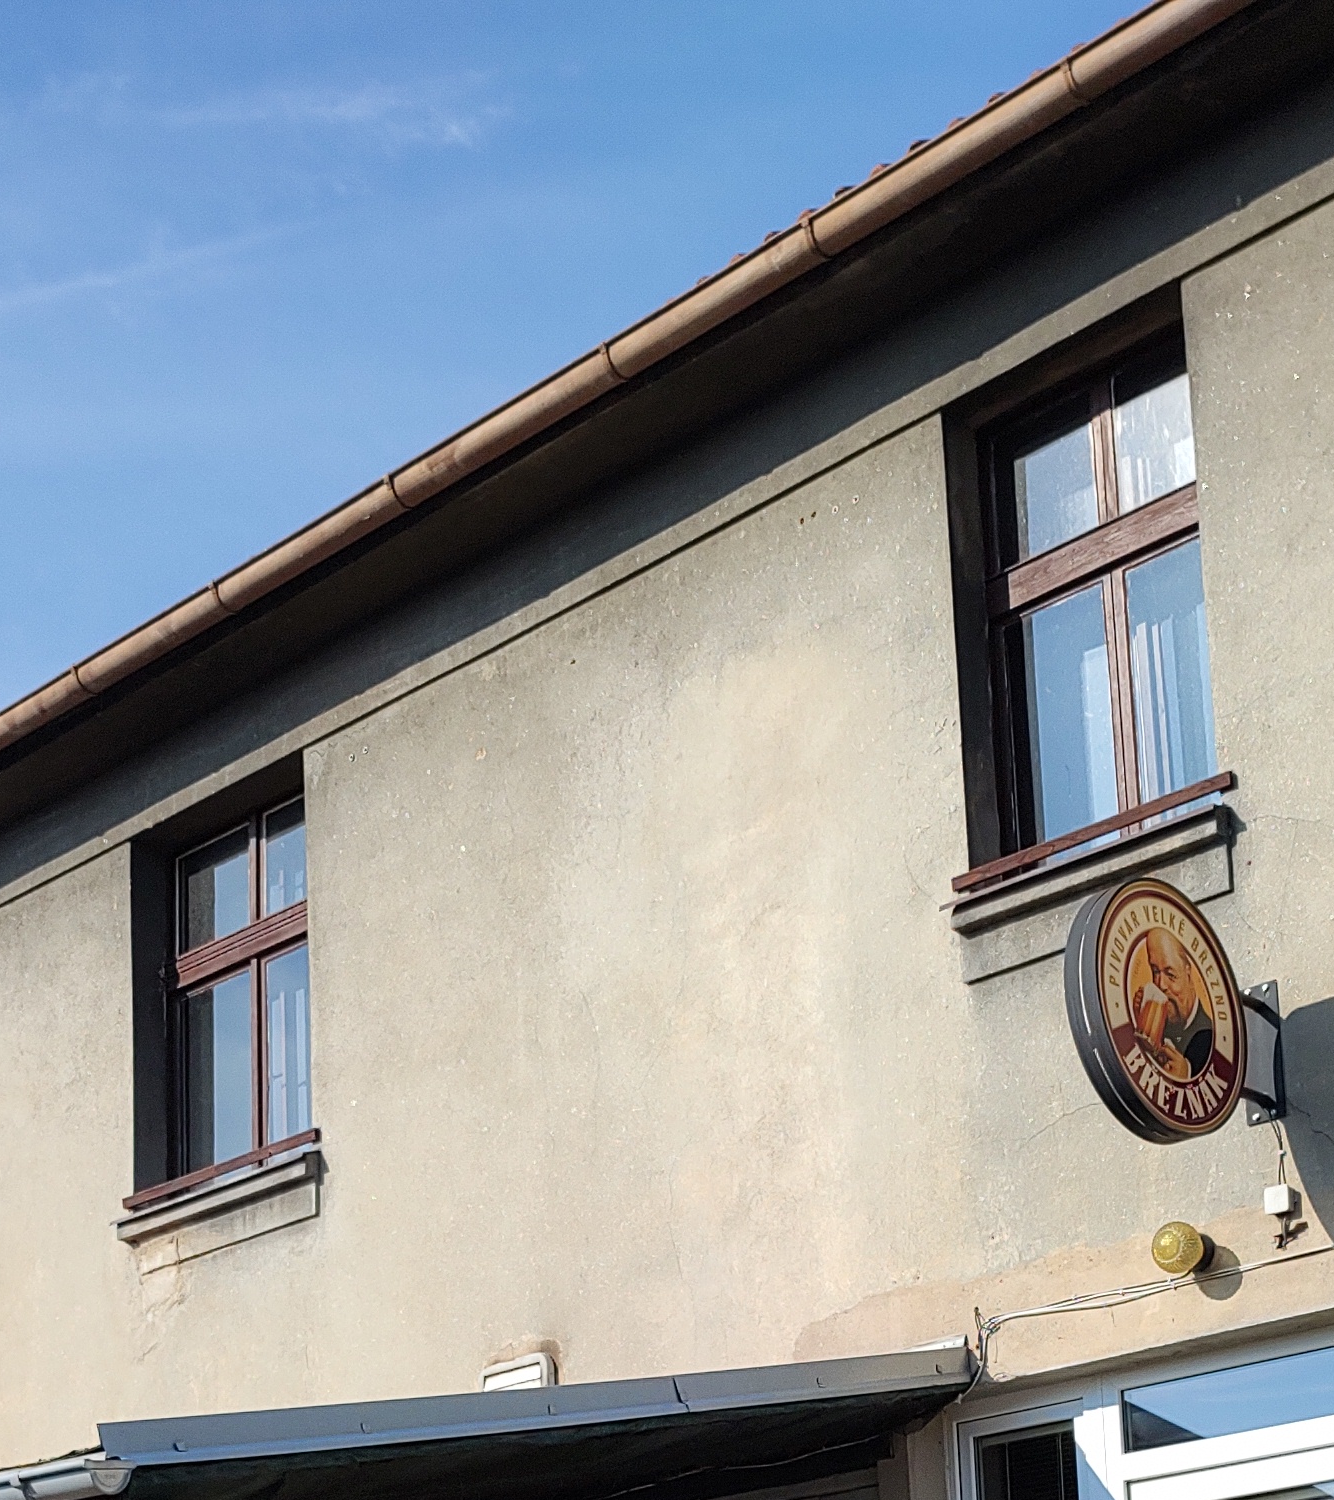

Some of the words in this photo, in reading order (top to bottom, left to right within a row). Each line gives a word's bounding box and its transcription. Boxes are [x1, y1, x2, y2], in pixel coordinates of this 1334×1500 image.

[1109, 910, 1141, 987] PIVOVAR
[1143, 905, 1186, 937] VELKÉ
[1122, 1043, 1228, 1120] BŘEZŇÁK
